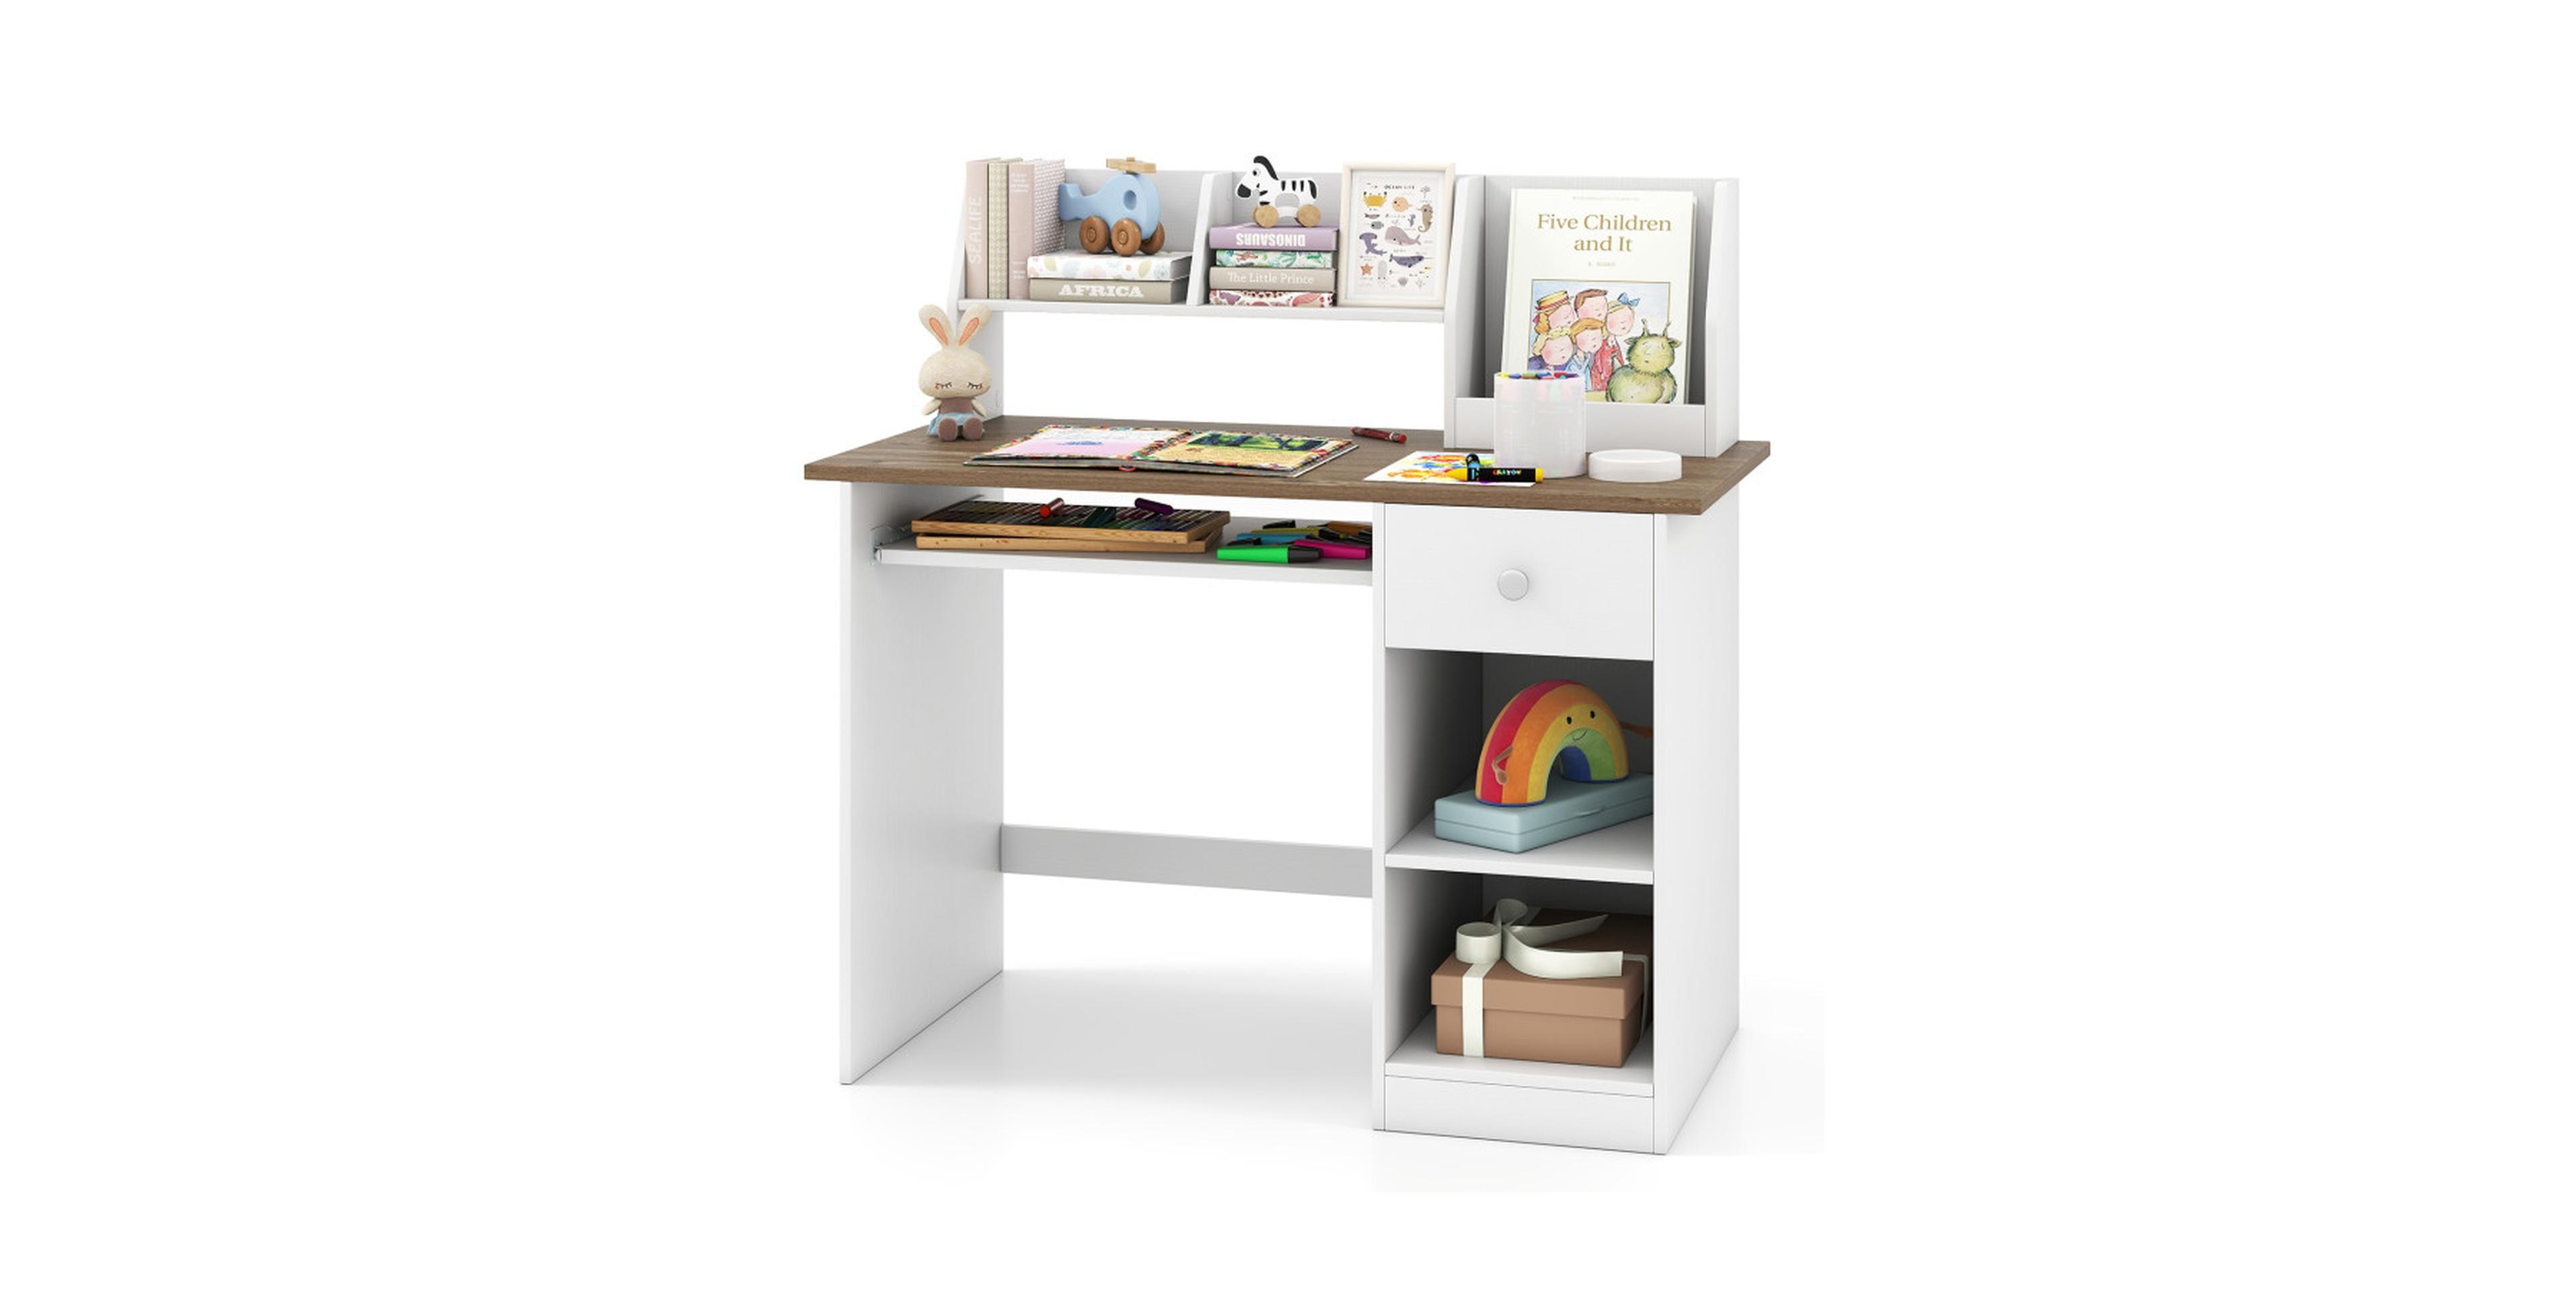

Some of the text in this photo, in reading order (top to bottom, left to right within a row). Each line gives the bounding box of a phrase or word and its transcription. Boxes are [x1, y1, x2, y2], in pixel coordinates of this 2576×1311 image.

[1537, 214, 1672, 231] Five Children
[969, 197, 981, 264] SEALIFE
[1236, 233, 1305, 246] DINOSAURS
[1574, 236, 1633, 252] and It
[1227, 271, 1314, 284] The Little Prince
[1059, 284, 1143, 297] AFRICA
